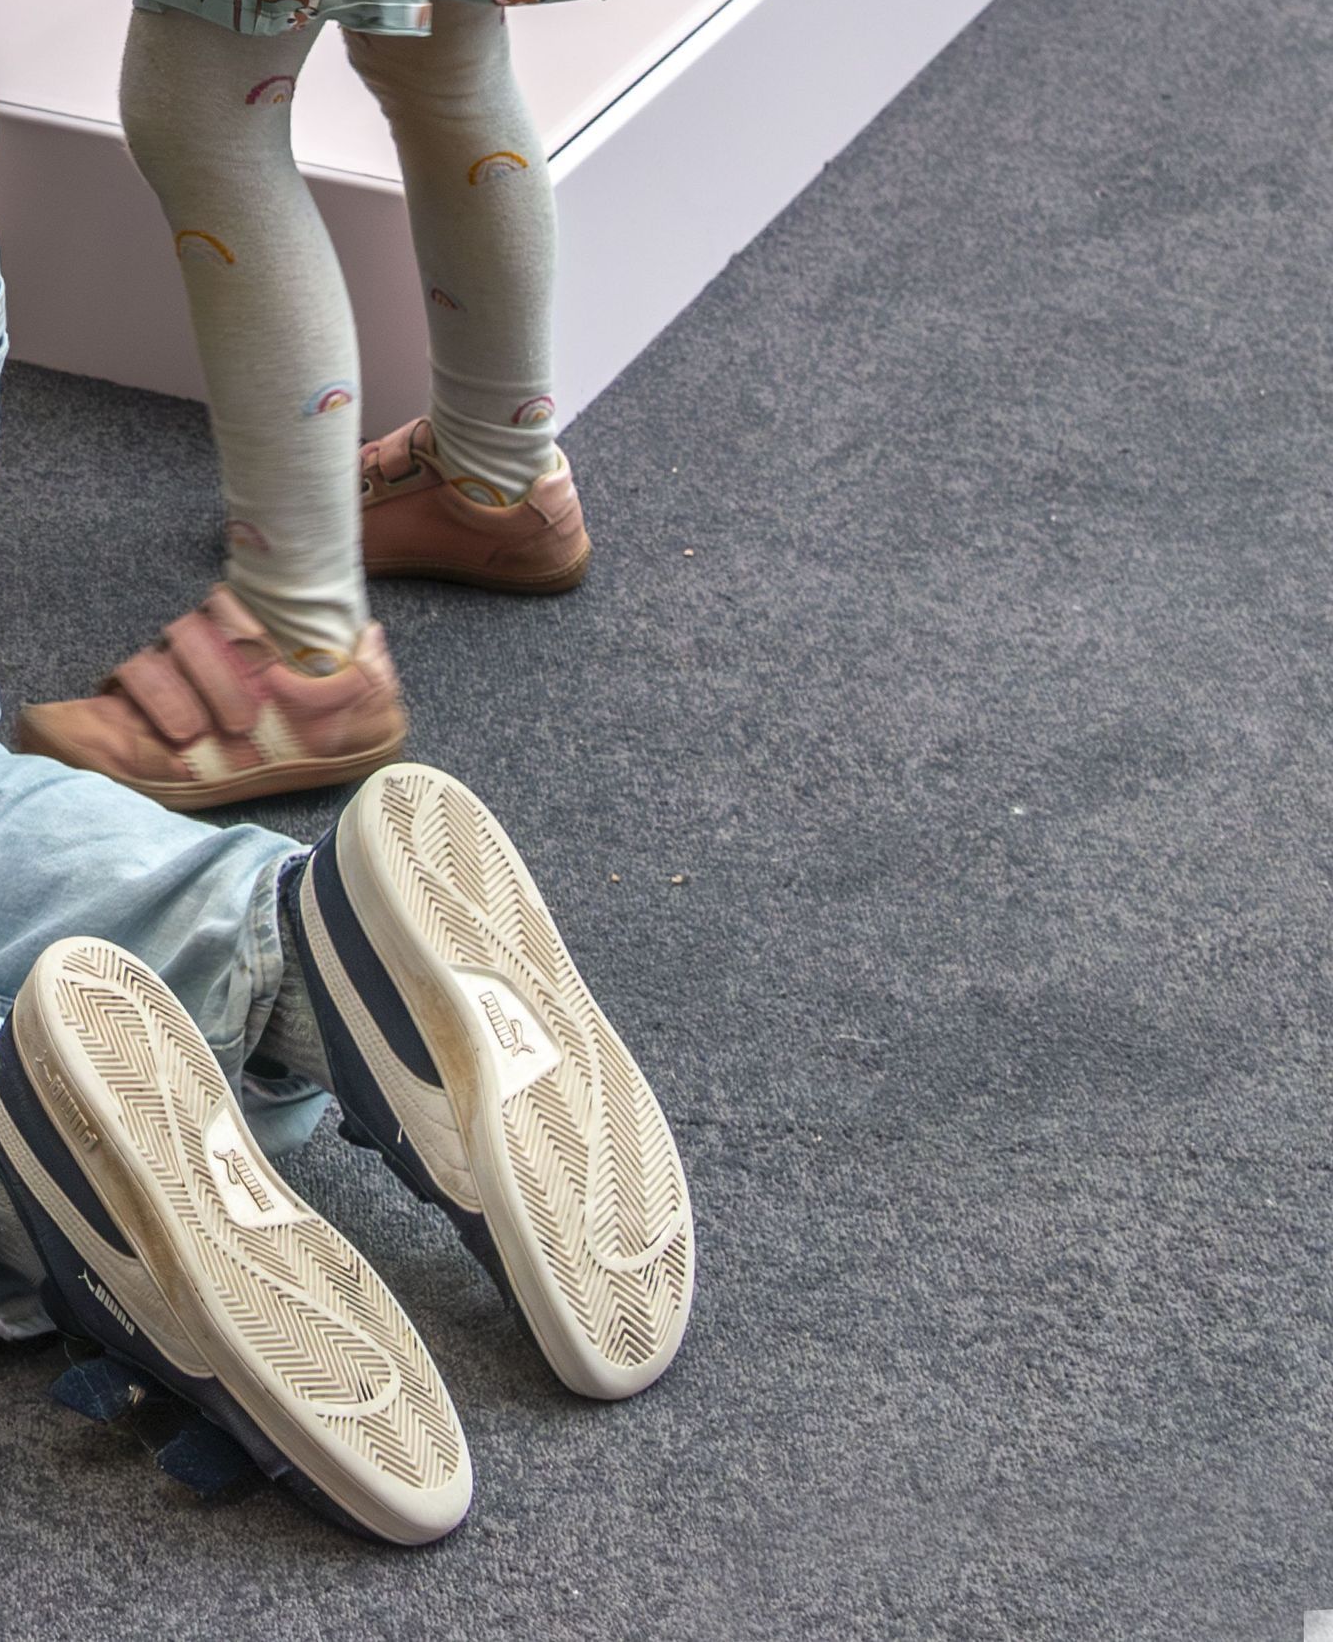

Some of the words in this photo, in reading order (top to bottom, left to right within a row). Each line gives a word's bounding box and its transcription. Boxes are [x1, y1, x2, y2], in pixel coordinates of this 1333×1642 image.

[478, 990, 516, 1050] PUMA
[233, 1156, 275, 1213] PUMA
[94, 1283, 135, 1337] PUMA
